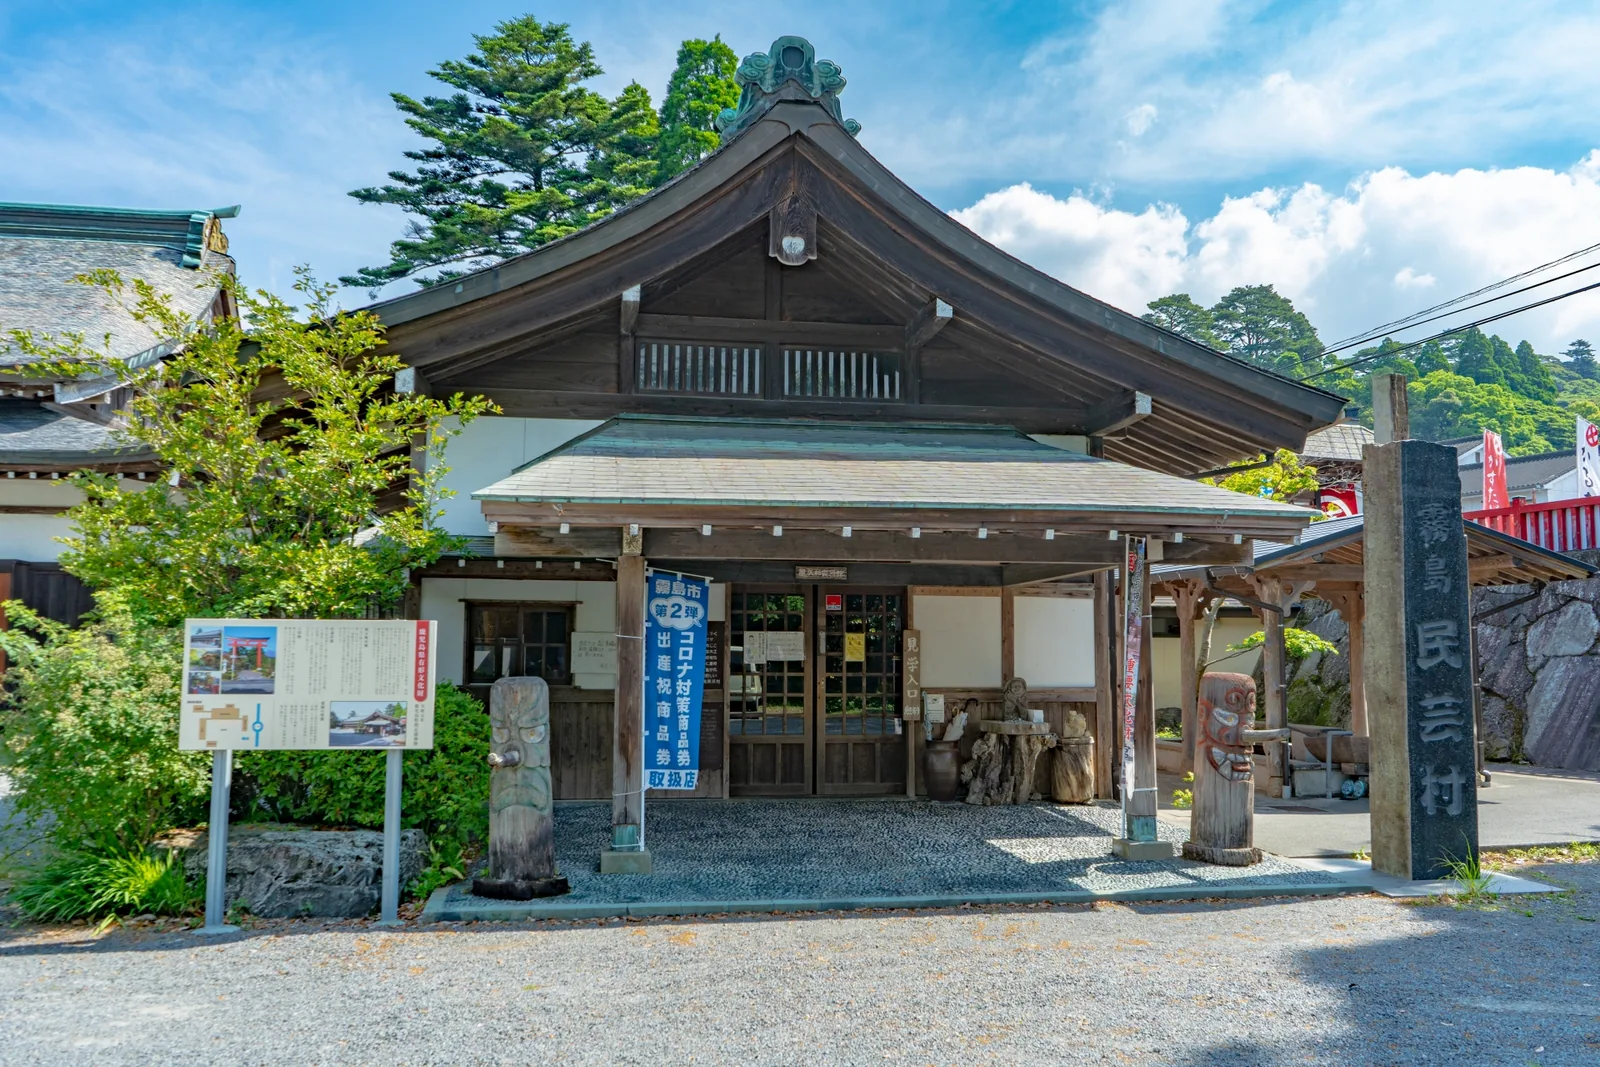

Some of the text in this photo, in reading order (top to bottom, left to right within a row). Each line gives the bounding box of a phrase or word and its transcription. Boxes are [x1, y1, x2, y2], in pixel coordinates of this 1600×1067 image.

[655, 579, 702, 599] 霧島市
[655, 603, 699, 620] 第2弾
[416, 628, 427, 697] 鹿児島県有形文化財
[906, 637, 919, 698] 見学入口
[1416, 503, 1467, 816] 霧島民芸村
[656, 631, 672, 766] 出産祝商品券
[676, 631, 694, 766] コロナ対策商品券
[649, 770, 696, 789] 取扱店
